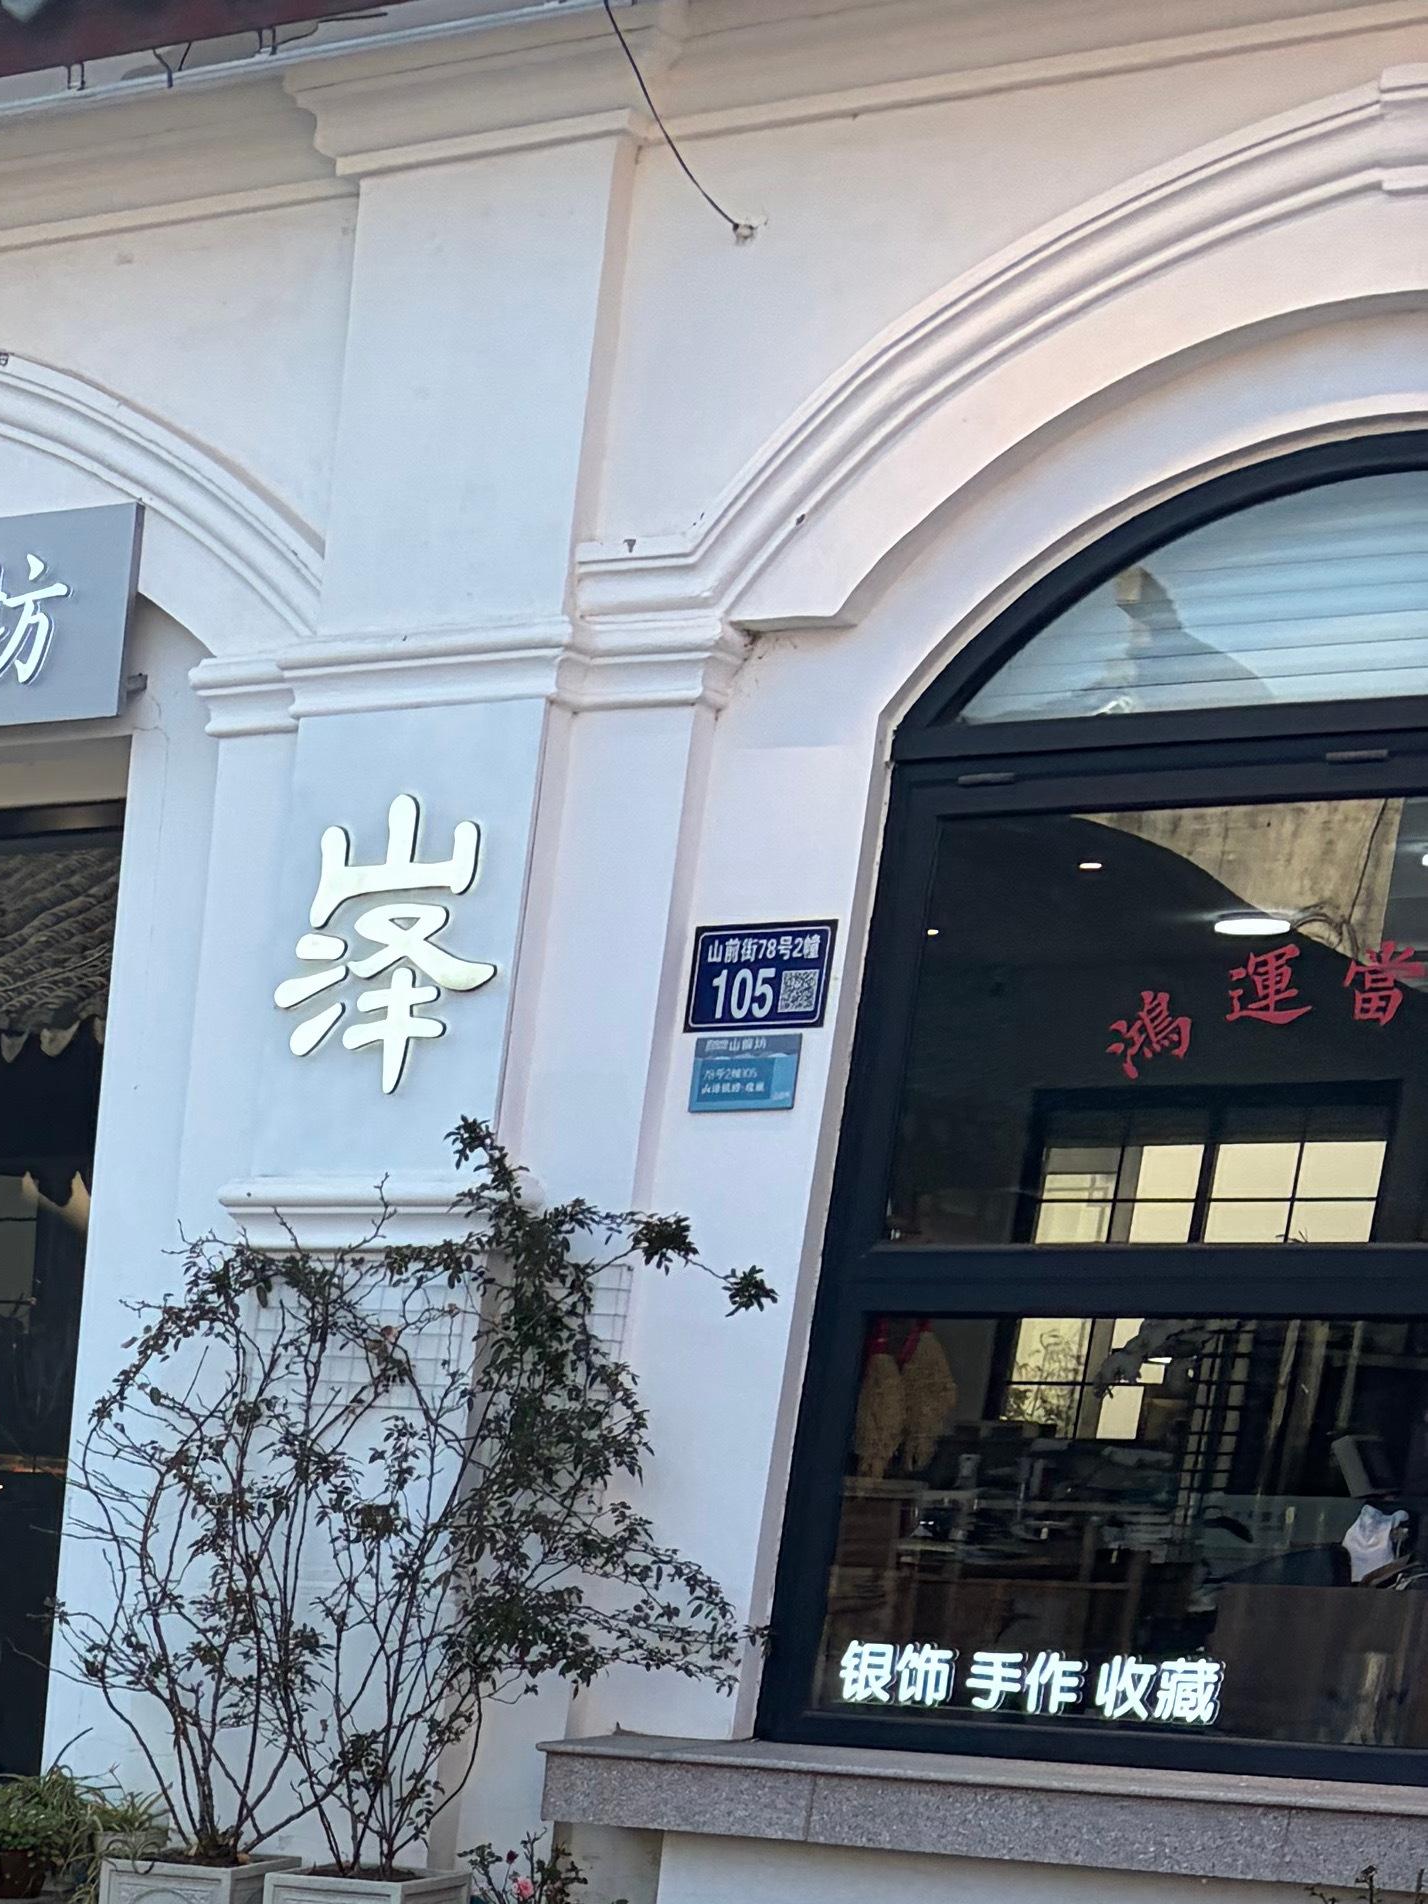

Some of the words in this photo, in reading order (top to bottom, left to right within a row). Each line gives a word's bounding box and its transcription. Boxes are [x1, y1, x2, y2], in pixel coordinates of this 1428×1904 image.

[707, 934, 821, 963] 山前街78号2幢
[712, 967, 776, 1019] 105
[840, 1639, 955, 1706] 银饰
[965, 1651, 1085, 1714] 手作
[1095, 1655, 1223, 1723] 收藏
